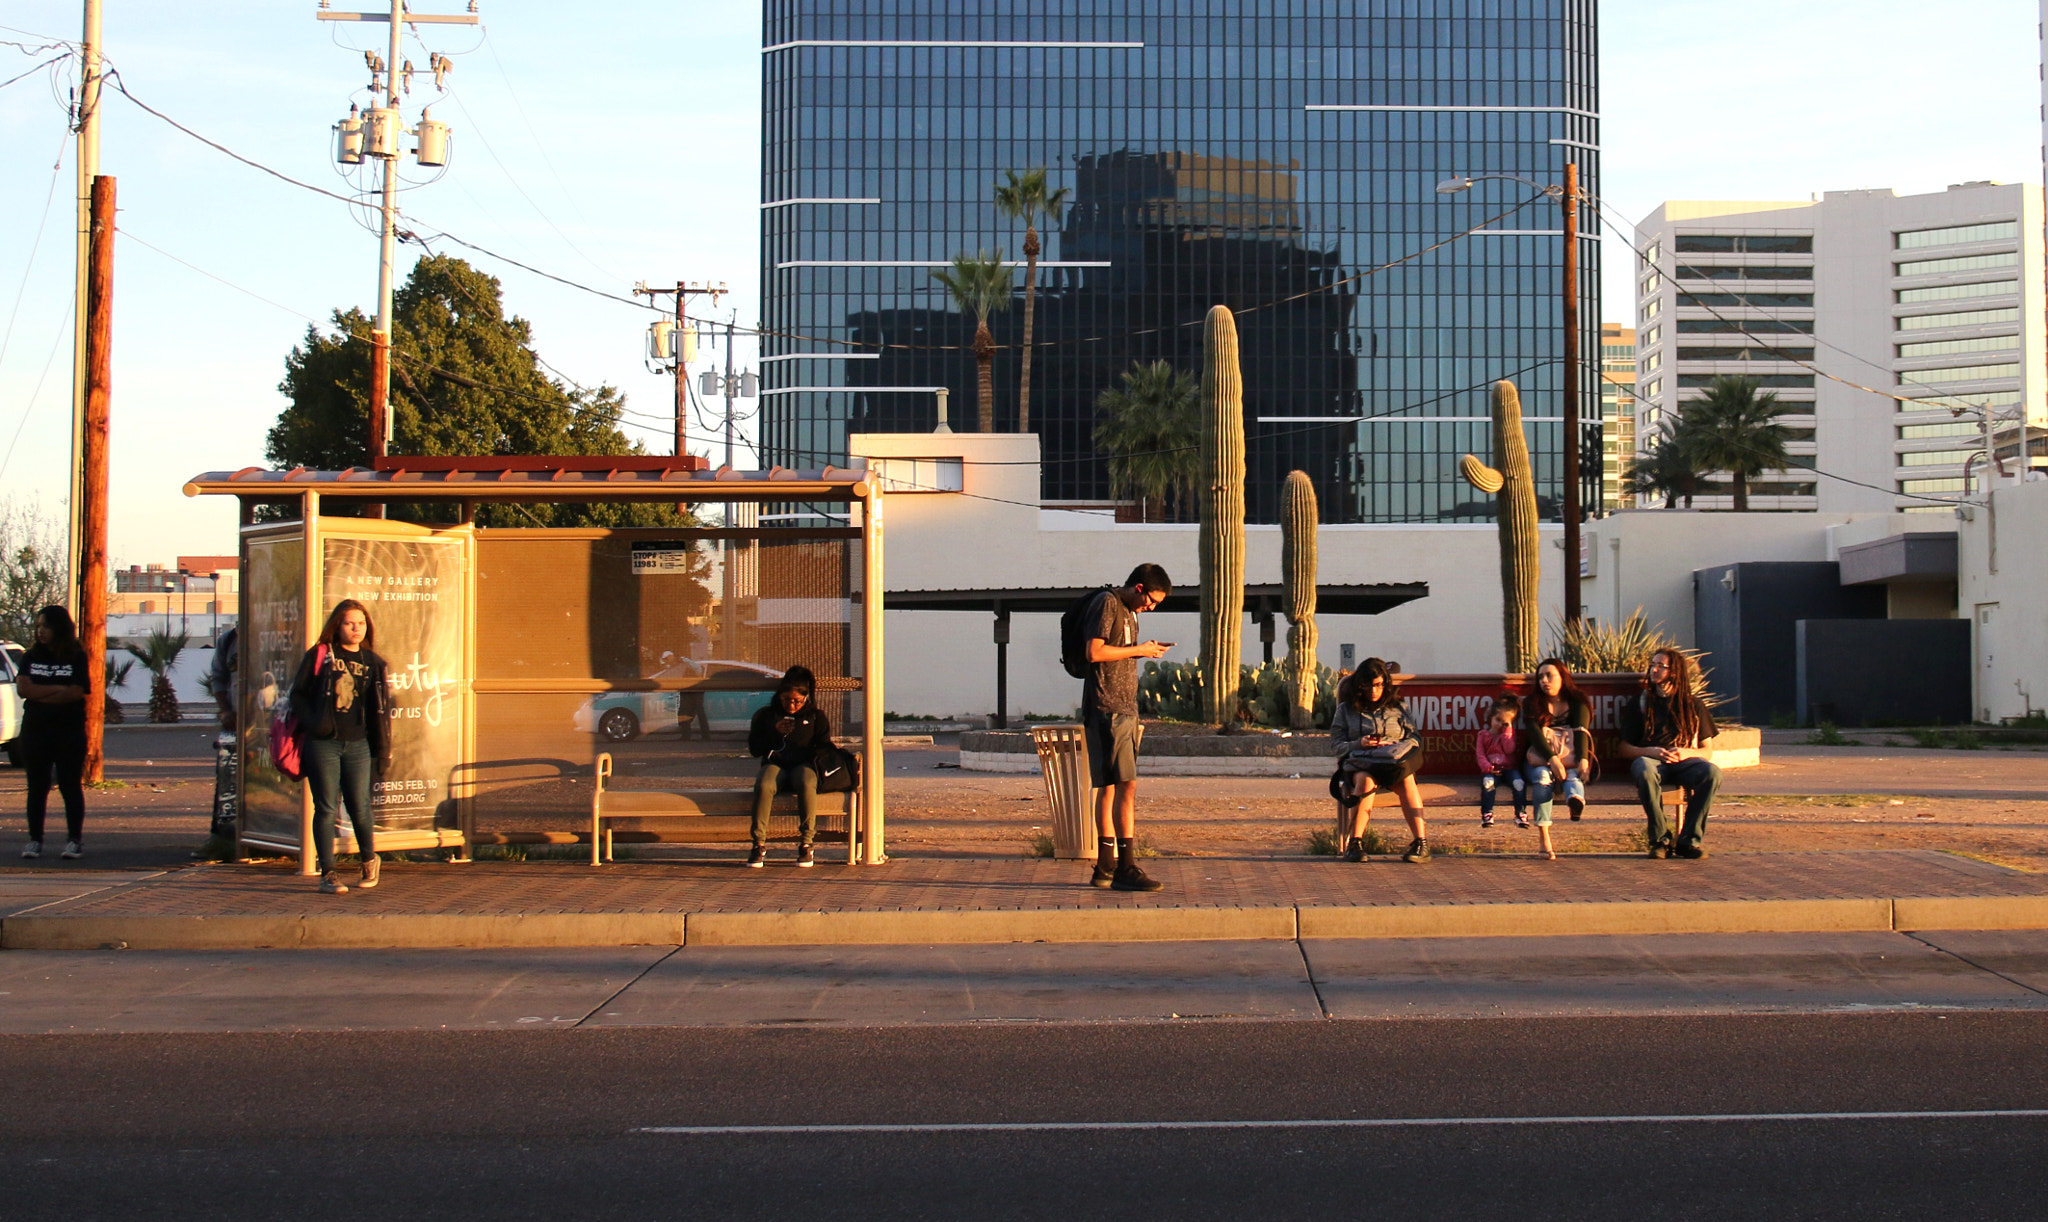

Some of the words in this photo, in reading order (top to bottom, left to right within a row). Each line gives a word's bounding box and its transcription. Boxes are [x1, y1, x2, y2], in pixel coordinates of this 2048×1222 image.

[633, 552, 657, 560] STOP#
[346, 576, 353, 585] A
[358, 577, 383, 585] NEW
[387, 577, 439, 586] GALLERY
[358, 593, 380, 601] NEW
[384, 593, 438, 601] EXHIBITION
[253, 601, 299, 623] MATTRESS
[258, 630, 294, 651] STORES
[388, 652, 448, 727] uty
[390, 707, 404, 719] or
[407, 707, 422, 719] us
[1403, 695, 1493, 731] WRECK?
[373, 781, 404, 792] OPENS
[406, 780, 427, 790] FEB.
[428, 779, 438, 789] 10
[373, 793, 426, 805] HEARD.ORG
